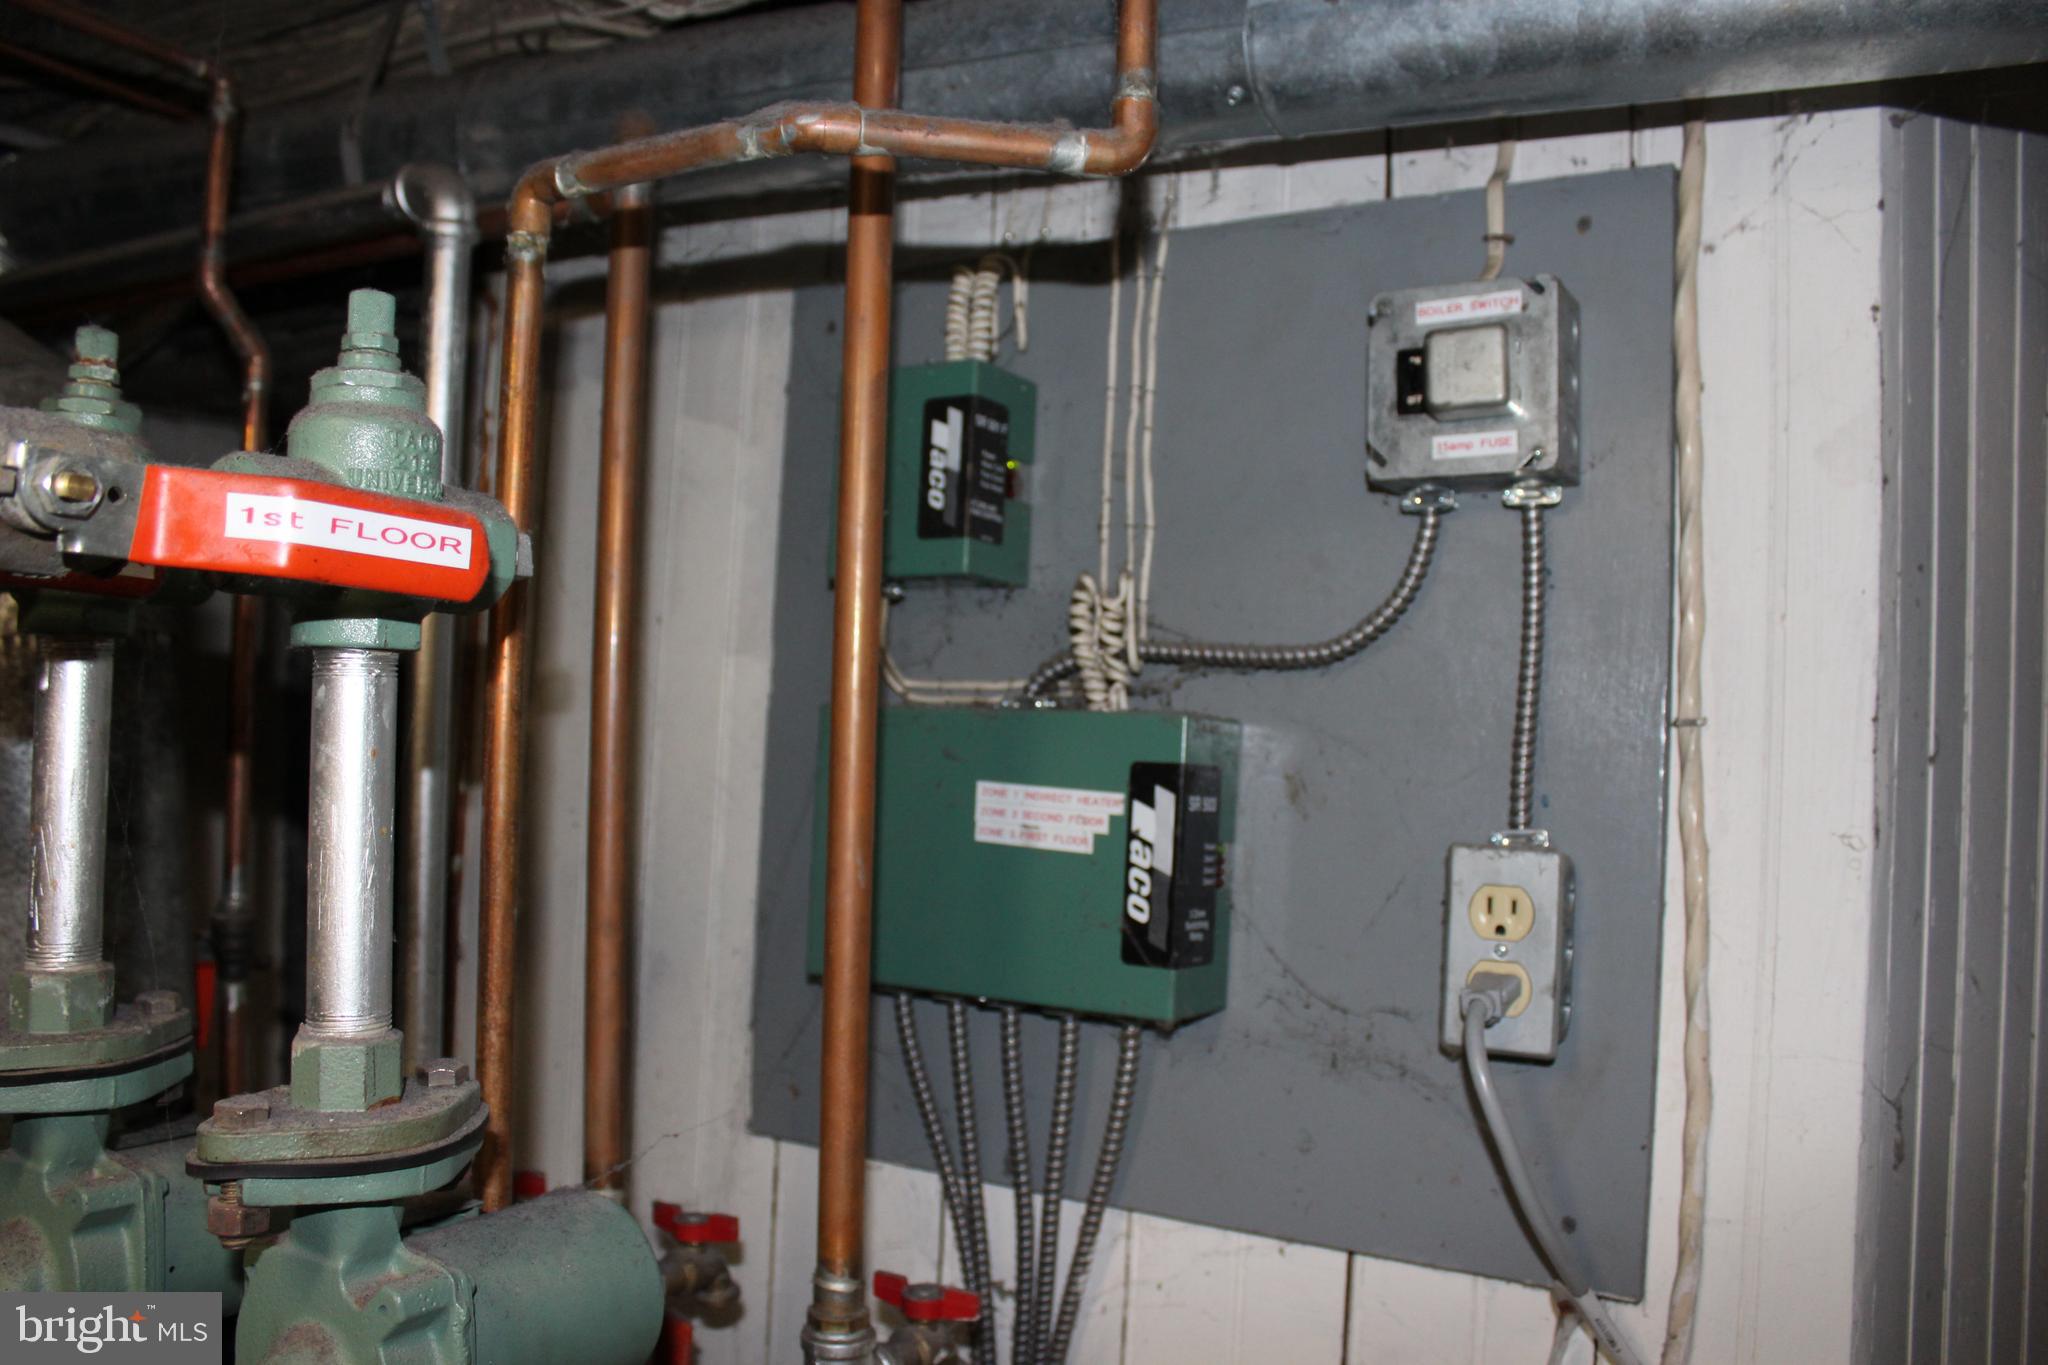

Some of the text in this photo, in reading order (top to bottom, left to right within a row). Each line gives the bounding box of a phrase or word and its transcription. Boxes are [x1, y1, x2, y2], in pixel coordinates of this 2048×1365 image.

[1417, 297, 1520, 318] BOILER SWITCH
[1480, 436, 1513, 448] FUSE
[241, 507, 463, 555] 1st FLOOR
